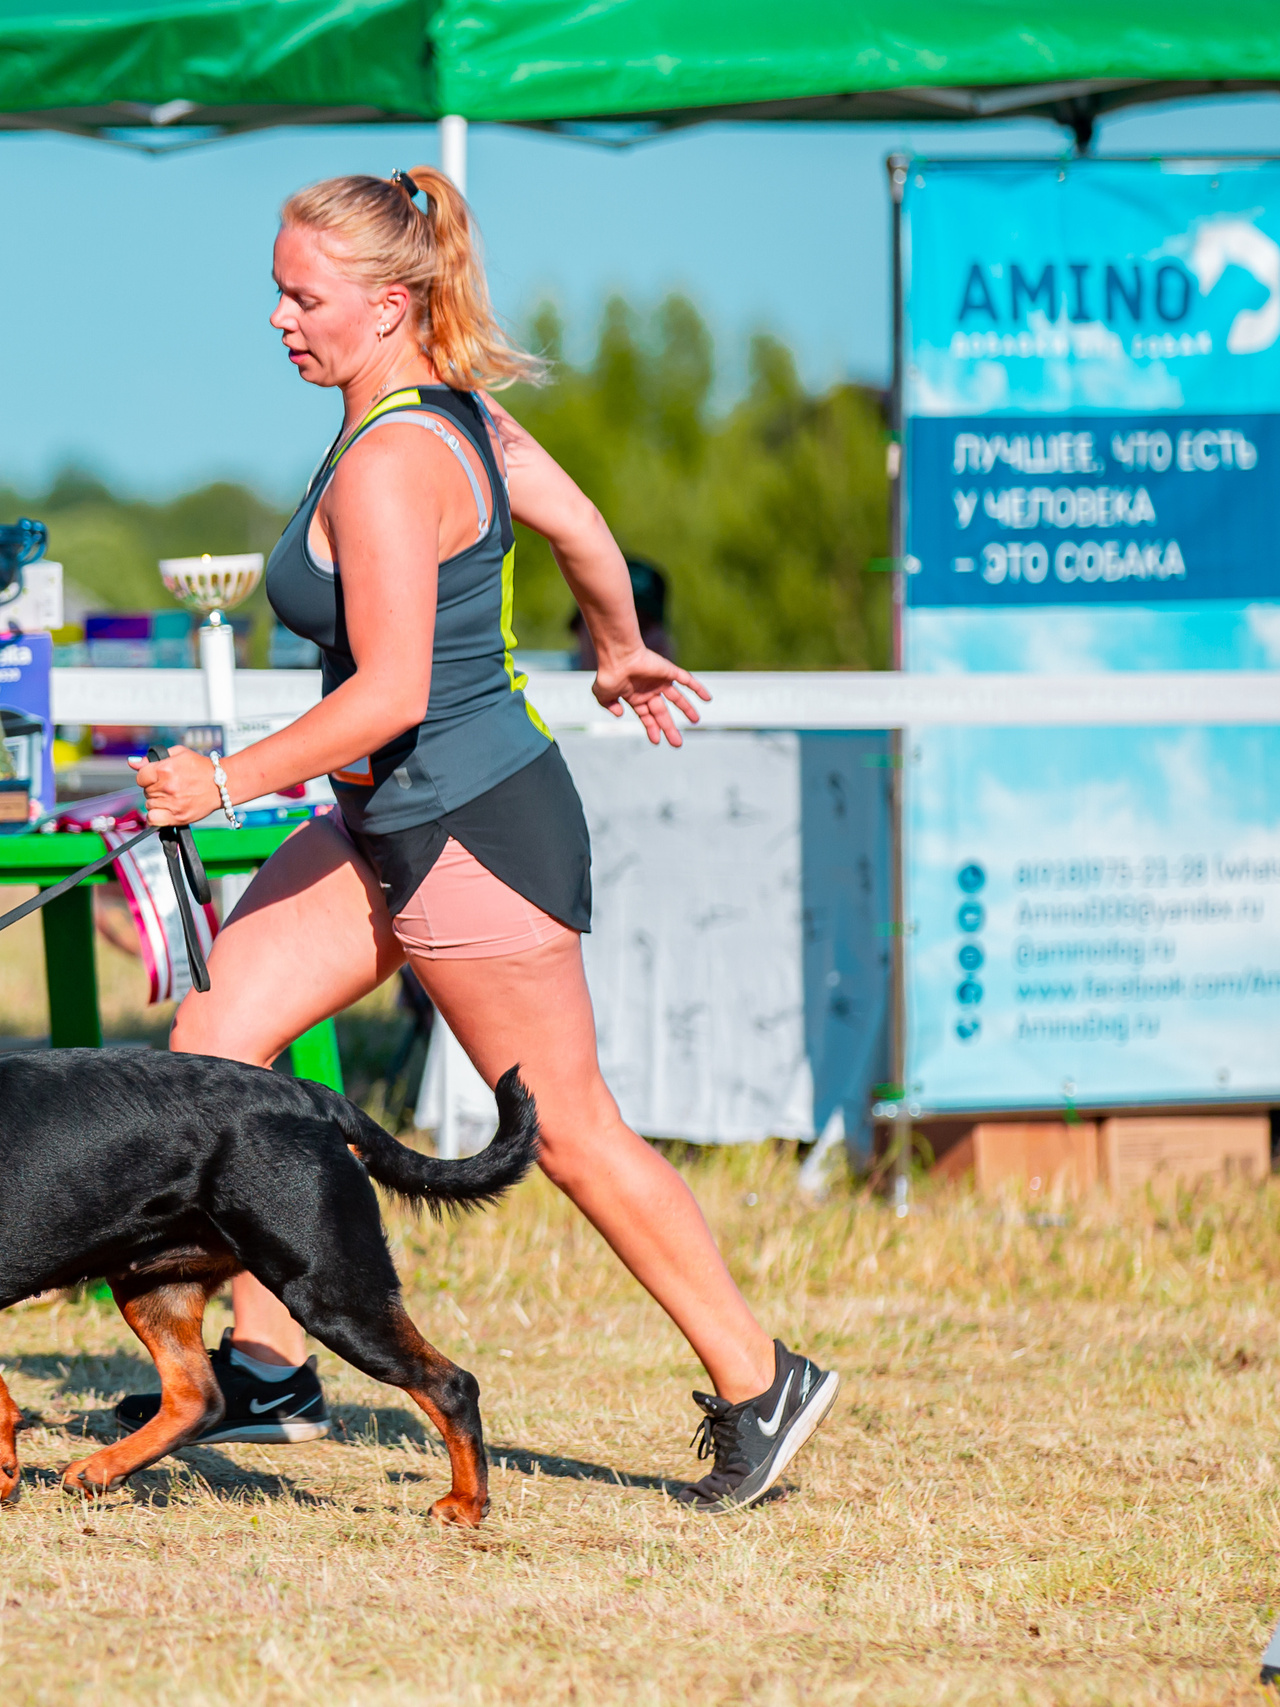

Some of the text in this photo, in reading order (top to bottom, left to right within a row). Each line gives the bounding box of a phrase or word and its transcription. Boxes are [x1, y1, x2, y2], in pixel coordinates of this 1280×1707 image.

[957, 262, 1192, 323] AMINO
[1112, 430, 1173, 472] ЧТО
[1177, 428, 1258, 472] ЕСТЬ
[954, 485, 1157, 529] У ЧЕЛОВЕКА
[981, 541, 1049, 584] ЭТО
[1055, 538, 1187, 583] СОБАКА
